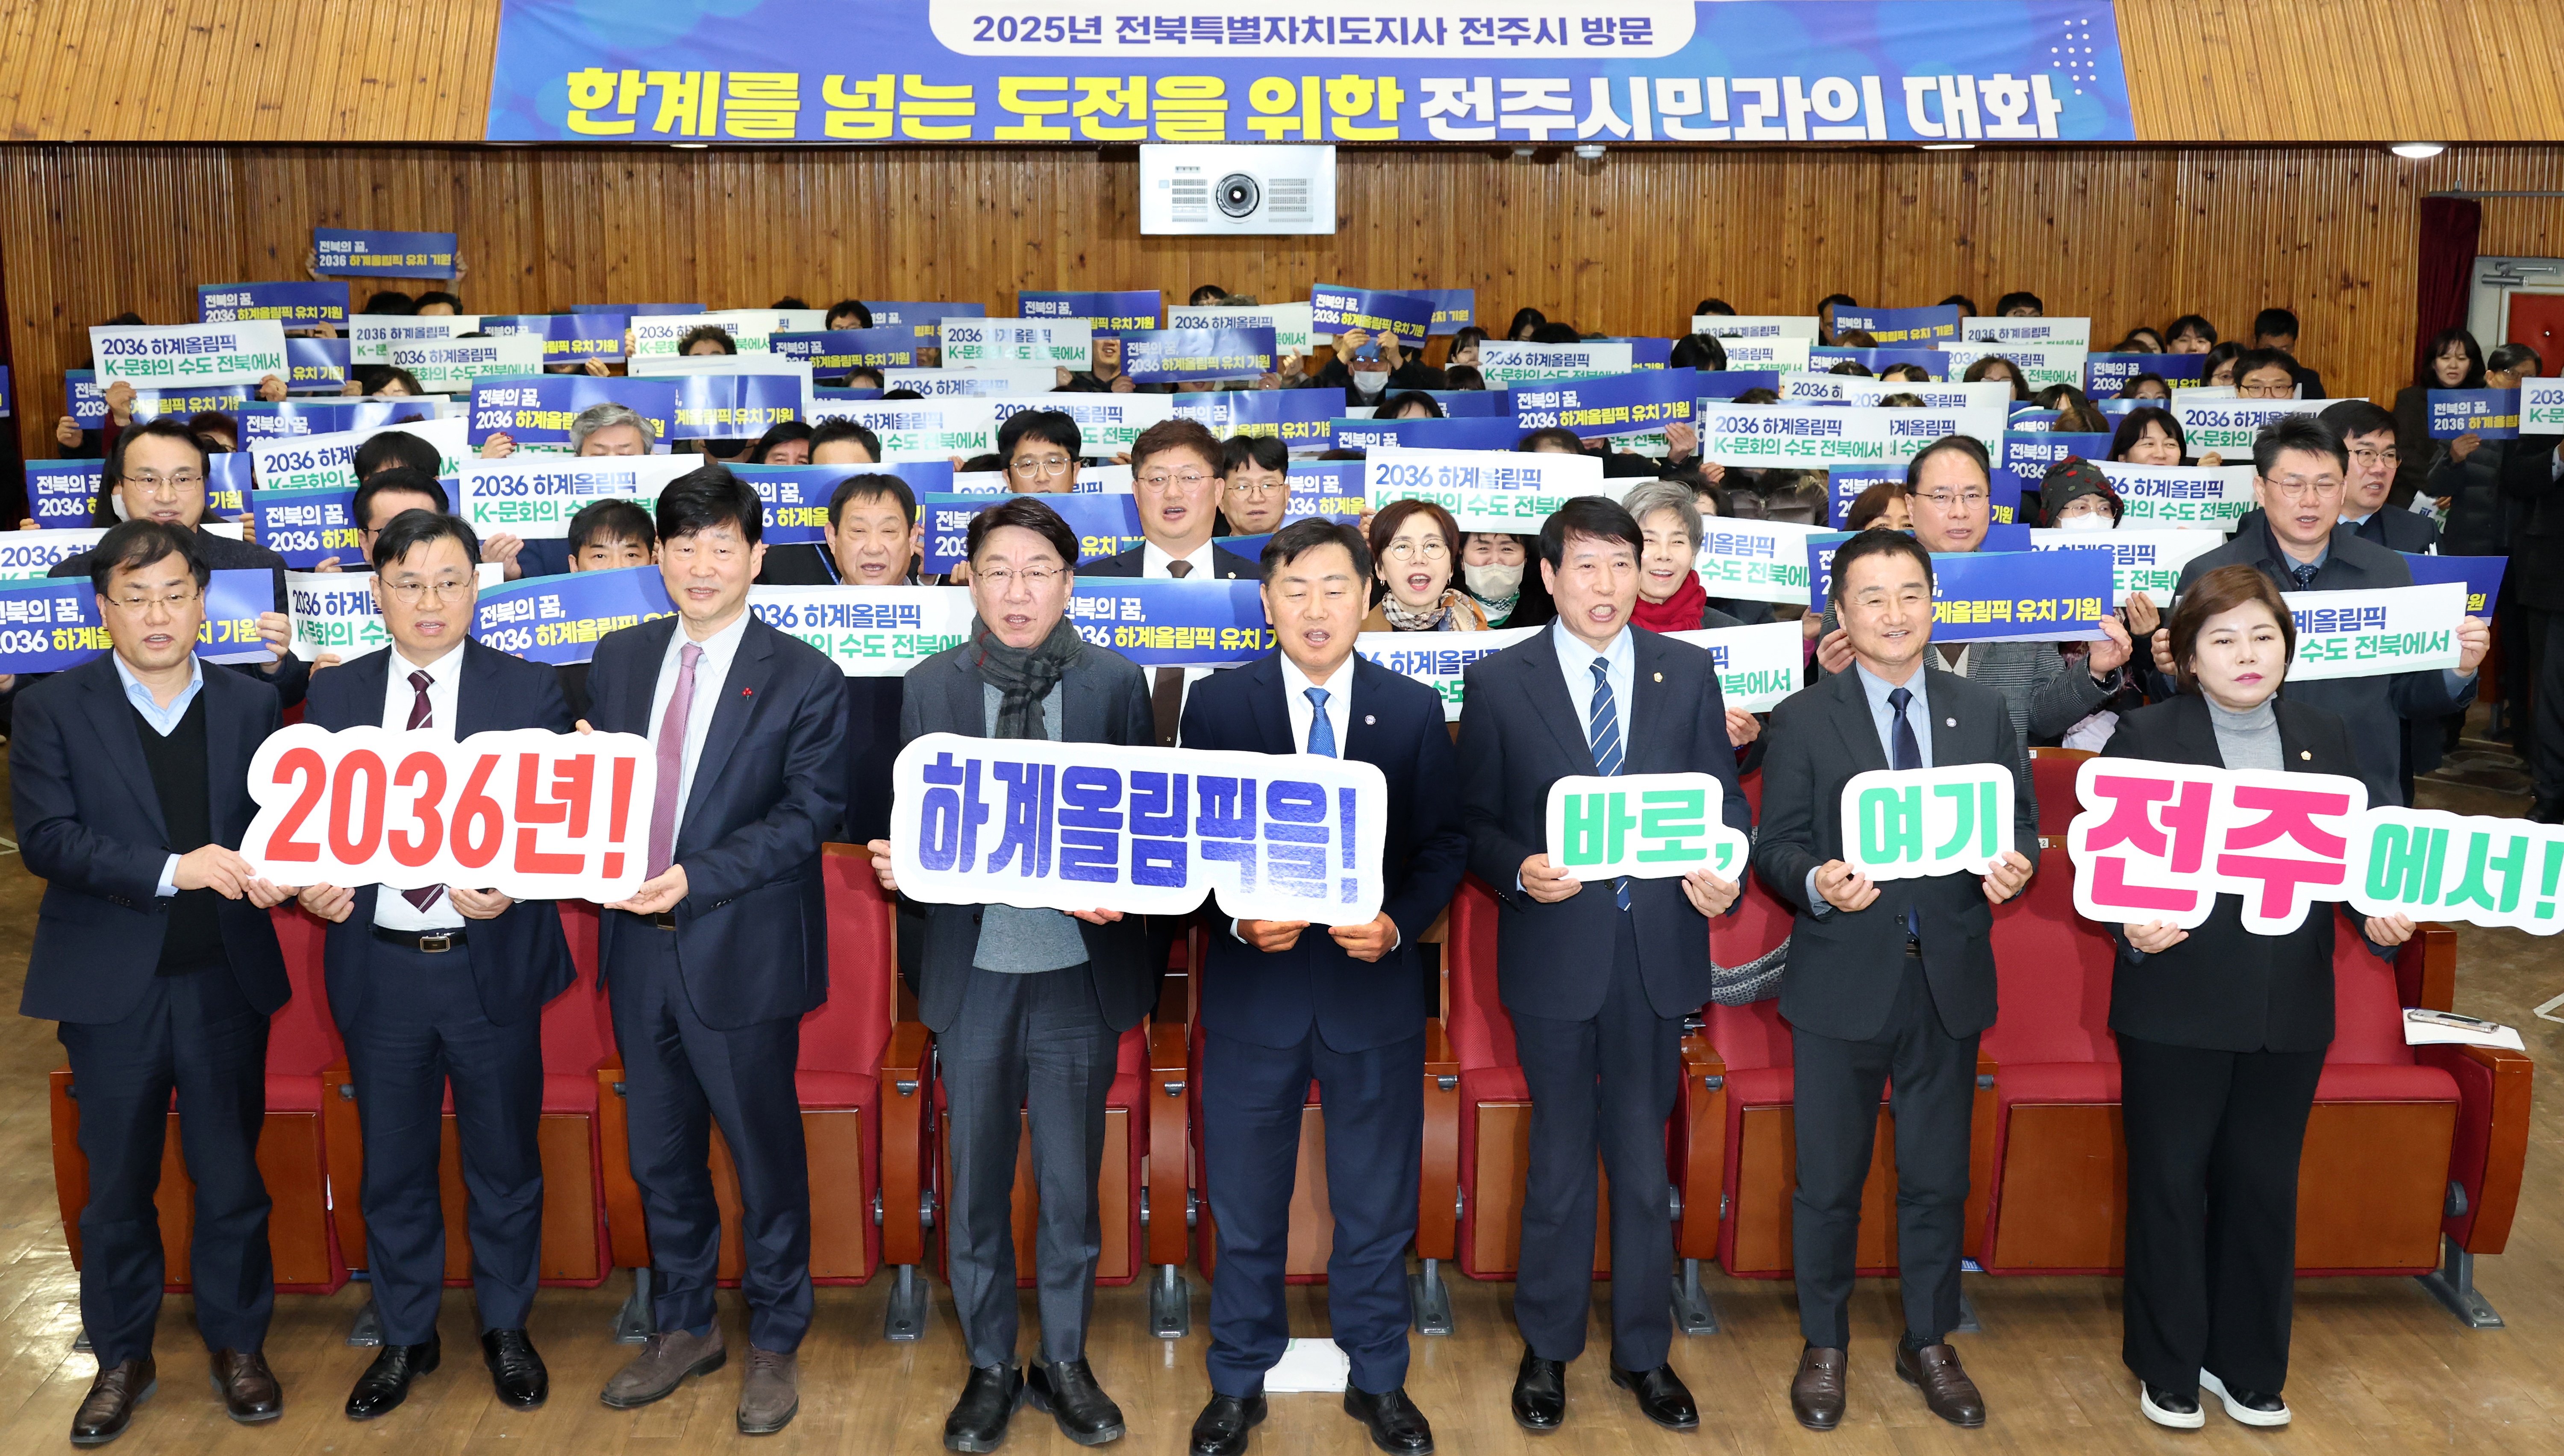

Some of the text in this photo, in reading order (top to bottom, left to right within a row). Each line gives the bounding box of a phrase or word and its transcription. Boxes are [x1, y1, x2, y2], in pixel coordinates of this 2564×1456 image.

[973, 15, 1653, 46] 2025년 전북특별자치도지사 전주시 방문
[567, 68, 2062, 141] 한계를 넘는 도전을 위한 전주시민과의 대화
[319, 255, 347, 267] 2036
[205, 293, 255, 308] 전북의 꿈,
[1026, 302, 1057, 314] 전북의
[1316, 294, 1345, 309] 전북의
[205, 309, 237, 323] 2036
[295, 306, 318, 319] 유치
[320, 306, 344, 319] 기원
[1111, 317, 1132, 330] 유치
[1134, 317, 1155, 330] 기원
[1175, 317, 1209, 329] 2036
[1313, 309, 1340, 325] 2036
[1341, 313, 1393, 332] 하계올림픽
[357, 326, 450, 340] 2036 하계올림픽
[639, 326, 674, 340] 2036
[949, 329, 983, 342] 2036
[102, 334, 238, 355] 2036 하계올림픽
[571, 340, 619, 353] 유치 기원
[776, 342, 810, 354] 전북의
[105, 352, 282, 376] K-문화의 수도 전북에서
[394, 348, 497, 364] 2036 하계올림픽
[812, 355, 863, 368] 하계올림픽
[864, 353, 887, 367] 유치
[888, 352, 911, 365] 기원
[1128, 359, 1160, 373] 2036
[1162, 357, 1220, 372] 하계올림픽
[1247, 355, 1271, 368] 기원
[1526, 353, 1590, 368] 하계올림픽
[293, 367, 318, 381] 유치
[2028, 370, 2078, 384] 전북에서
[2094, 363, 2126, 375] 전북의
[1792, 382, 1828, 397] 2036
[2093, 378, 2123, 391] 2036
[189, 396, 217, 411] 유치
[478, 388, 541, 408] 전북의 꿈,
[1517, 391, 1582, 409] 전북의 꿈,
[766, 408, 795, 424] 기원
[1519, 412, 1558, 429] 2036
[1560, 407, 1630, 427] 하계올림픽
[1632, 404, 1660, 420] 유치
[1662, 401, 1691, 419] 기원
[2186, 410, 2230, 427] 2036
[2434, 402, 2471, 416] 전북의
[247, 415, 312, 434] 전북의 꿈,
[476, 410, 513, 430] 2036
[863, 412, 944, 430] 하계올림픽
[1715, 417, 1759, 434] 2036
[1763, 418, 1843, 437] 하계올림픽
[2434, 418, 2465, 431] 2036
[887, 432, 920, 449] 수도
[1282, 422, 1309, 439] 유치
[1338, 432, 1401, 449] 전북의 꿈,
[2186, 430, 2253, 447] K-문화의
[1714, 437, 1781, 455] K-문화의
[1785, 439, 1817, 456] 수도
[1820, 439, 1883, 458] 전북에서
[2010, 443, 2052, 461] 전북의
[265, 451, 315, 473] 2036
[37, 475, 86, 495] 전북의
[472, 472, 637, 497] 2036 하계올림픽
[1323, 475, 1344, 495] 꿈,
[1376, 464, 1542, 491] 2036 하계올림픽
[780, 481, 805, 504] 꿈,
[2135, 479, 2224, 499] 하계올림픽
[39, 497, 85, 517] 2036
[209, 490, 244, 509] 기원
[1468, 494, 1509, 517] 수도
[266, 504, 349, 528] 전북의 꿈,
[474, 500, 559, 523] K-문화의
[1992, 505, 2014, 524] 기원
[2159, 502, 2196, 521] 수도
[268, 531, 319, 552] 2036
[1081, 536, 1117, 557] 유치
[2, 546, 63, 567] 2036
[1701, 558, 1742, 581] 수도
[55, 598, 85, 623] 꿈,
[293, 590, 321, 616] 2036
[479, 594, 566, 629] 전북의 꿈,
[1120, 597, 1147, 622] 꿈,
[2016, 597, 2102, 622] 유치 기원
[804, 604, 921, 629] 하계올림픽
[218, 618, 262, 643] 기원
[1114, 625, 1216, 650] 하계올림픽
[1220, 628, 1261, 650] 유치
[839, 634, 886, 658] 수도
[2300, 630, 2450, 663] 수도 전북에서
[265, 747, 635, 879] 2036년!
[1859, 781, 1997, 865] 여기
[919, 752, 1357, 904] 하계올림픽을!
[1563, 789, 1733, 871] 바로,
